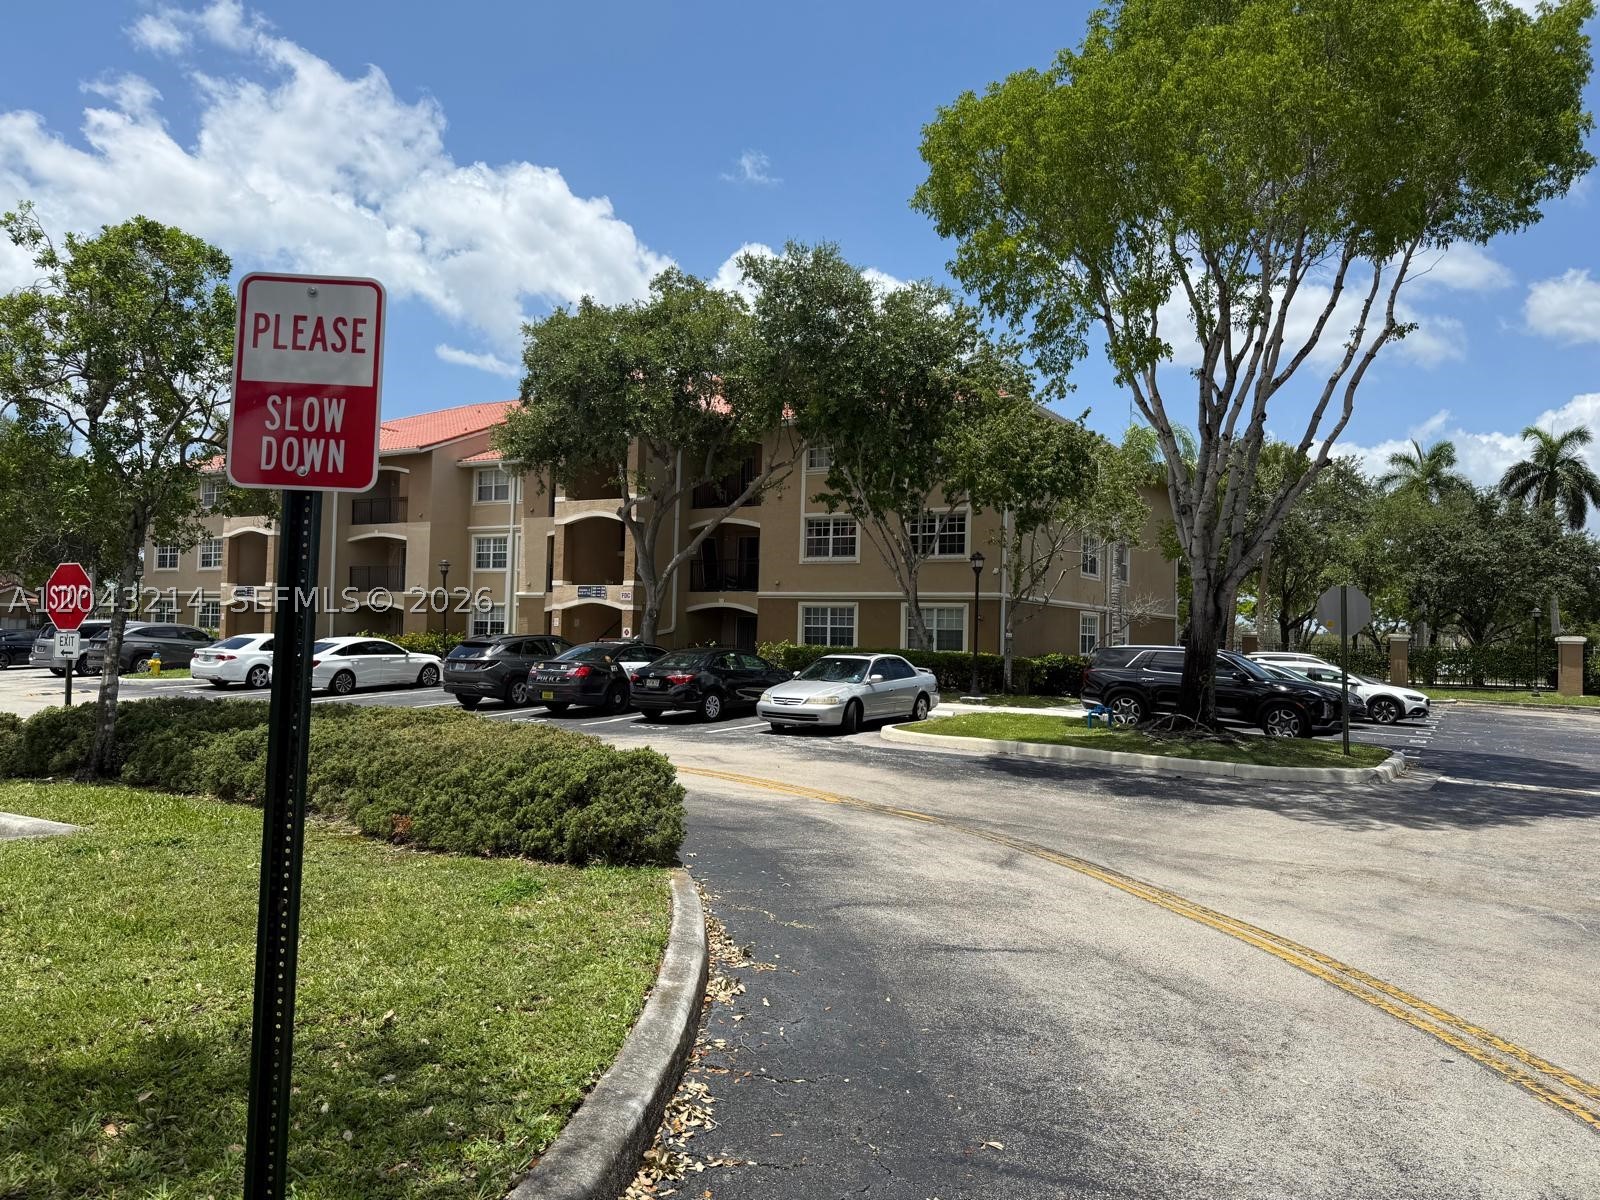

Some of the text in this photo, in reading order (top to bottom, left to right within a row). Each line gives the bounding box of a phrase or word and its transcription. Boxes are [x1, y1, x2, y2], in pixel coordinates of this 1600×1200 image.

[252, 312, 367, 353] PLEASE
[264, 394, 346, 433] SLOW
[260, 435, 346, 474] DOWN
[49, 584, 89, 610] STOP
[59, 636, 75, 647] EXIT
